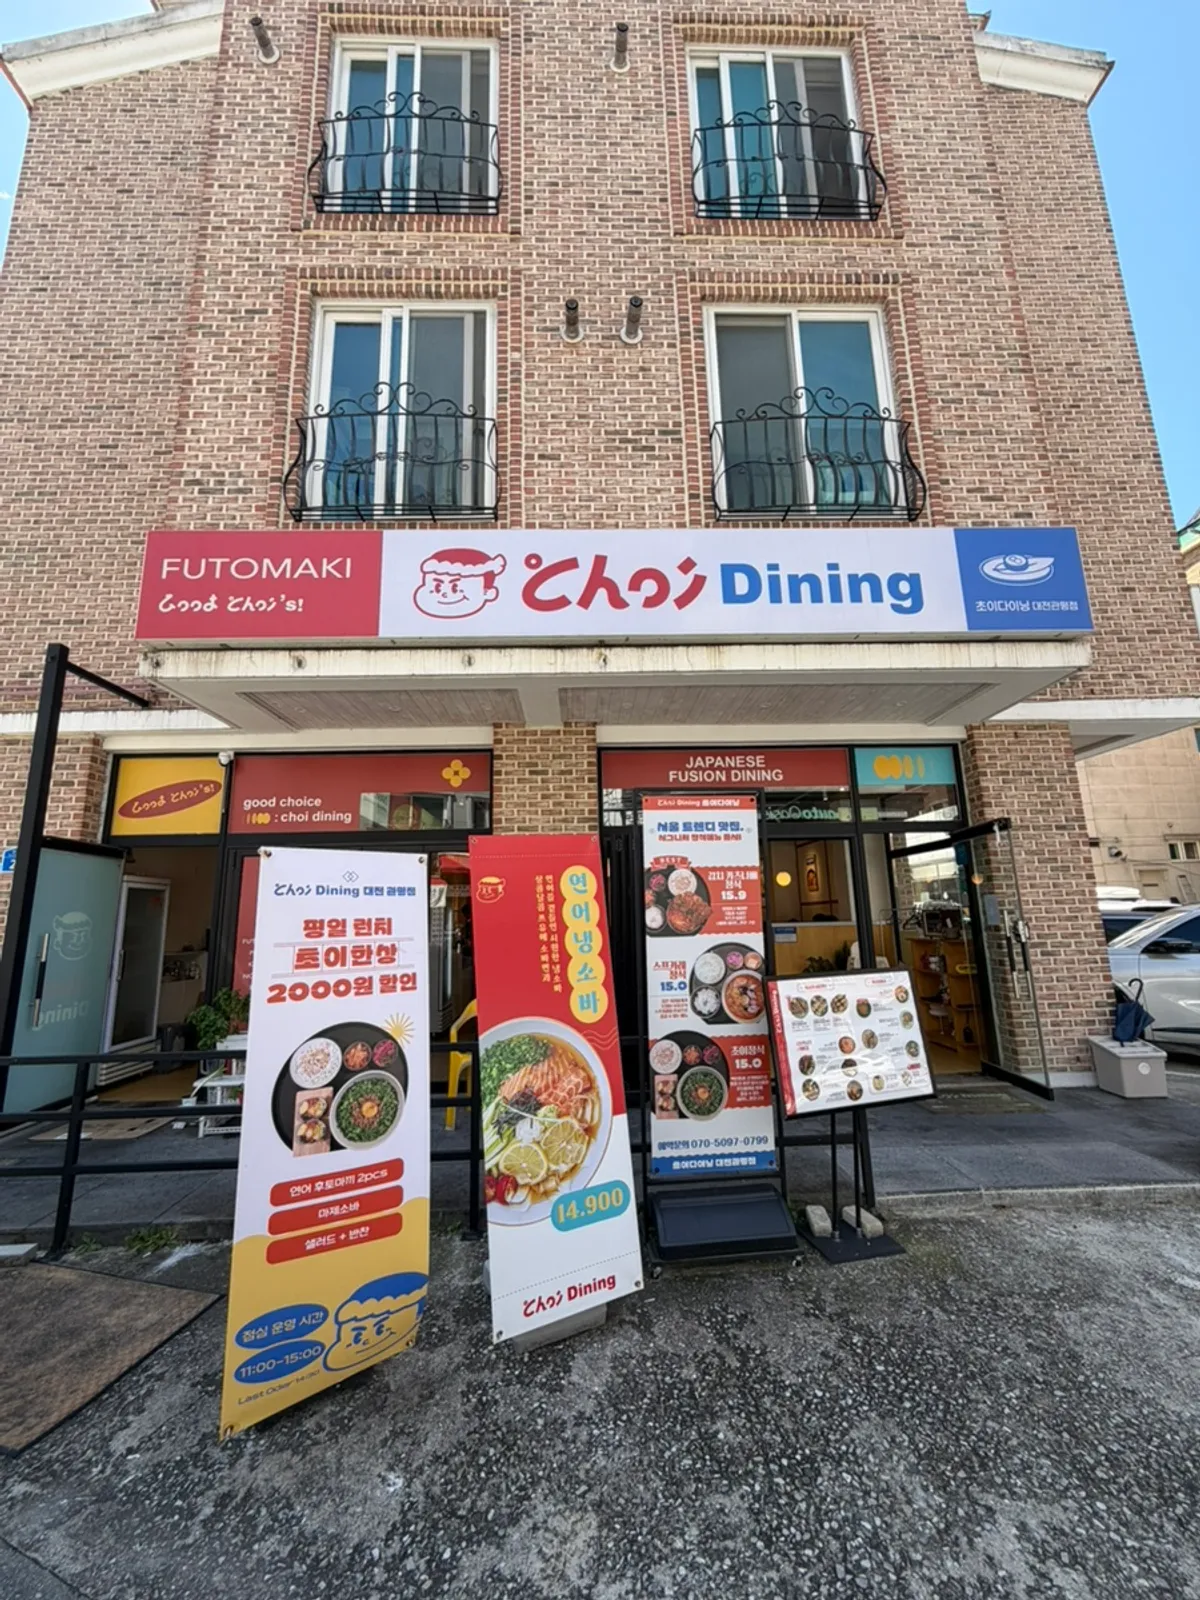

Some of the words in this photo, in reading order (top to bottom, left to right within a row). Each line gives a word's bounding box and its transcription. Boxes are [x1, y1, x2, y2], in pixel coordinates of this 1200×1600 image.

[160, 557, 353, 580] FUTOMAKI
[720, 562, 925, 615] Dining
[975, 600, 1031, 613] 초이다이닝
[685, 755, 766, 769] JAPANESE
[668, 769, 728, 783] FUSION
[730, 769, 784, 783] DINING
[243, 797, 277, 811] good
[279, 796, 322, 808] choice
[312, 810, 352, 825] dining
[657, 822, 679, 832] 서울
[682, 821, 717, 832] 트렌디
[315, 884, 360, 898] Dining
[363, 886, 384, 896] 대전
[721, 890, 747, 900] 15.9
[303, 918, 348, 939] 평일
[353, 917, 393, 937] 런치
[567, 872, 600, 1014] 연어냉소바
[266, 976, 374, 1004] 2000원
[378, 972, 418, 995] 할인
[660, 981, 687, 992] 15.0
[735, 1057, 762, 1069] 15.0
[691, 1135, 769, 1149] 070-5097-0799
[289, 1182, 312, 1198] 연어
[357, 1168, 389, 1184] 2pcs
[318, 1200, 360, 1219] 마제소바
[557, 1187, 624, 1224] 14.900
[304, 1233, 338, 1251] 샐러드
[348, 1225, 370, 1241] 반찬
[567, 1274, 617, 1302] Dining
[242, 1325, 268, 1343] 점심
[271, 1318, 297, 1335] 운영
[299, 1311, 324, 1325] 시간
[240, 1345, 322, 1378] 11:00-15:00
[237, 1391, 264, 1406] Last
